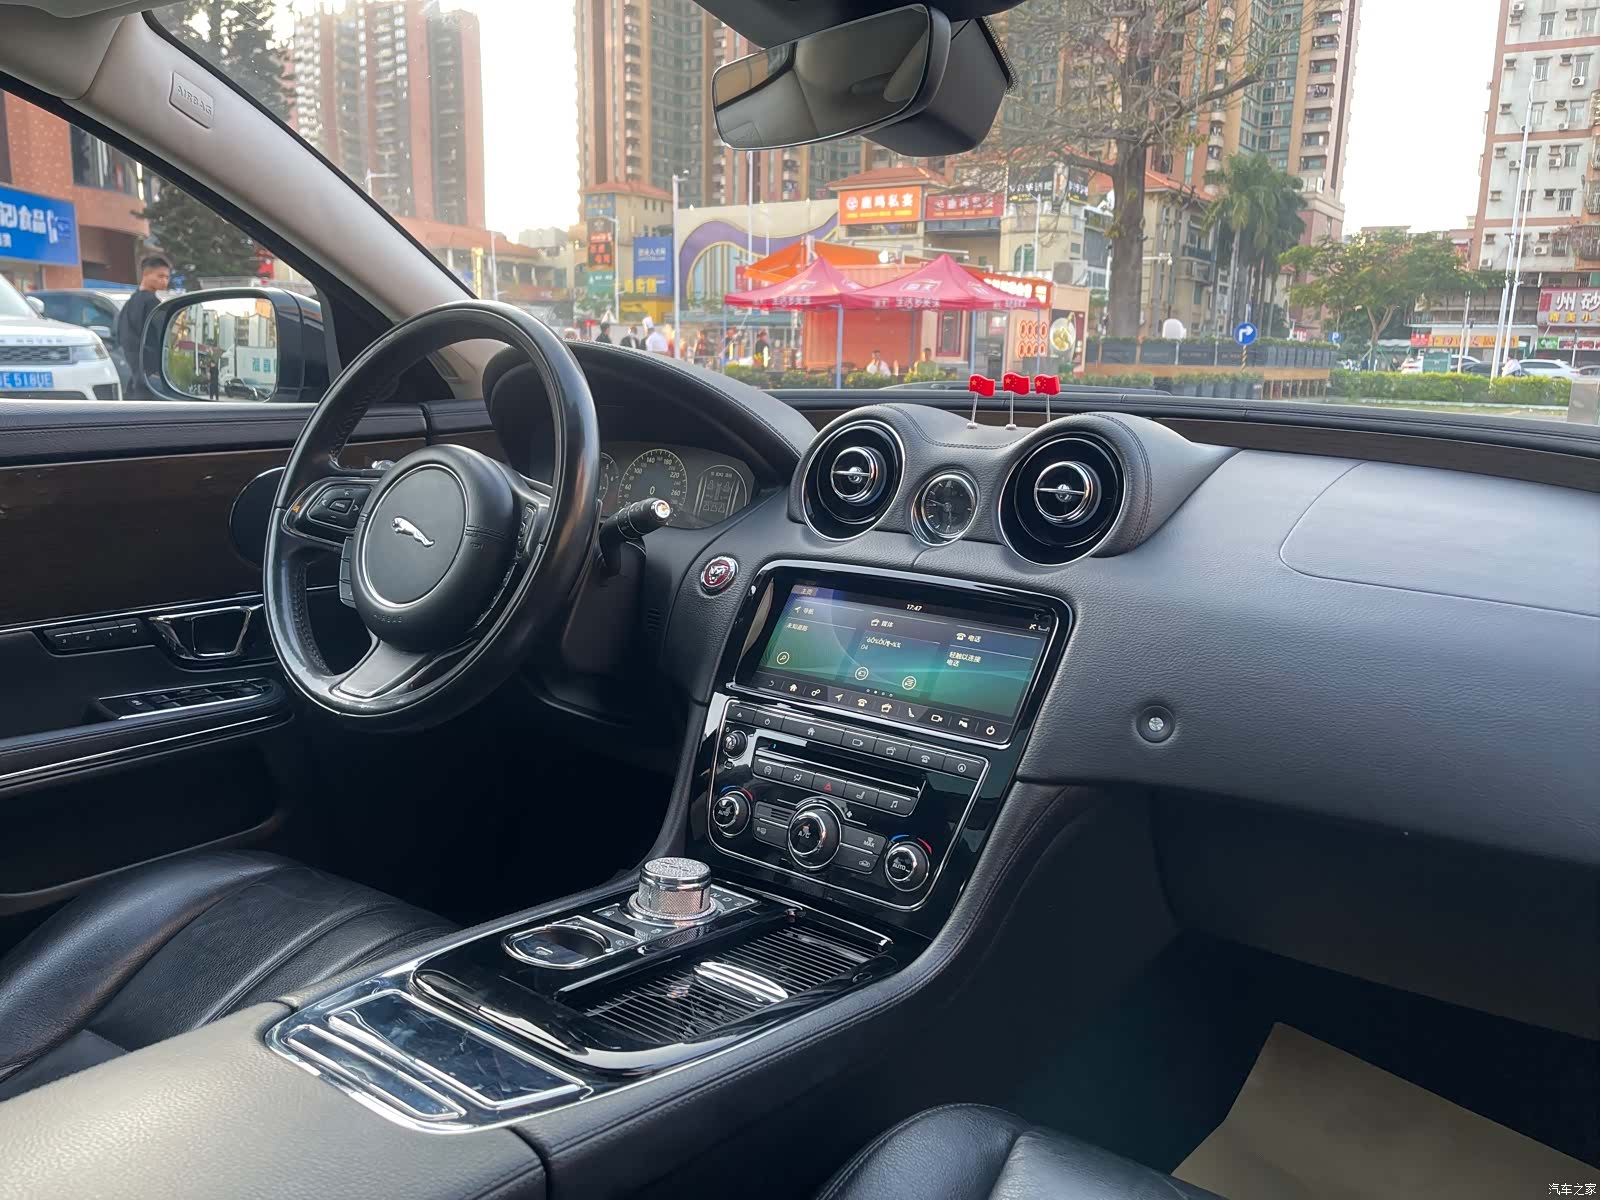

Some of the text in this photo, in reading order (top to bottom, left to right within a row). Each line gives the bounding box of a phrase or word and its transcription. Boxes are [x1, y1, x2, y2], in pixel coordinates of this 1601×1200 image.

[177, 85, 212, 116] AIRBAG
[669, 471, 680, 479] 220
[649, 485, 656, 495] 0
[967, 634, 982, 643] 电话
[946, 658, 960, 667] 电话
[798, 830, 811, 839] A/C
[863, 840, 875, 848] MAX
[892, 862, 906, 871] AUTO
